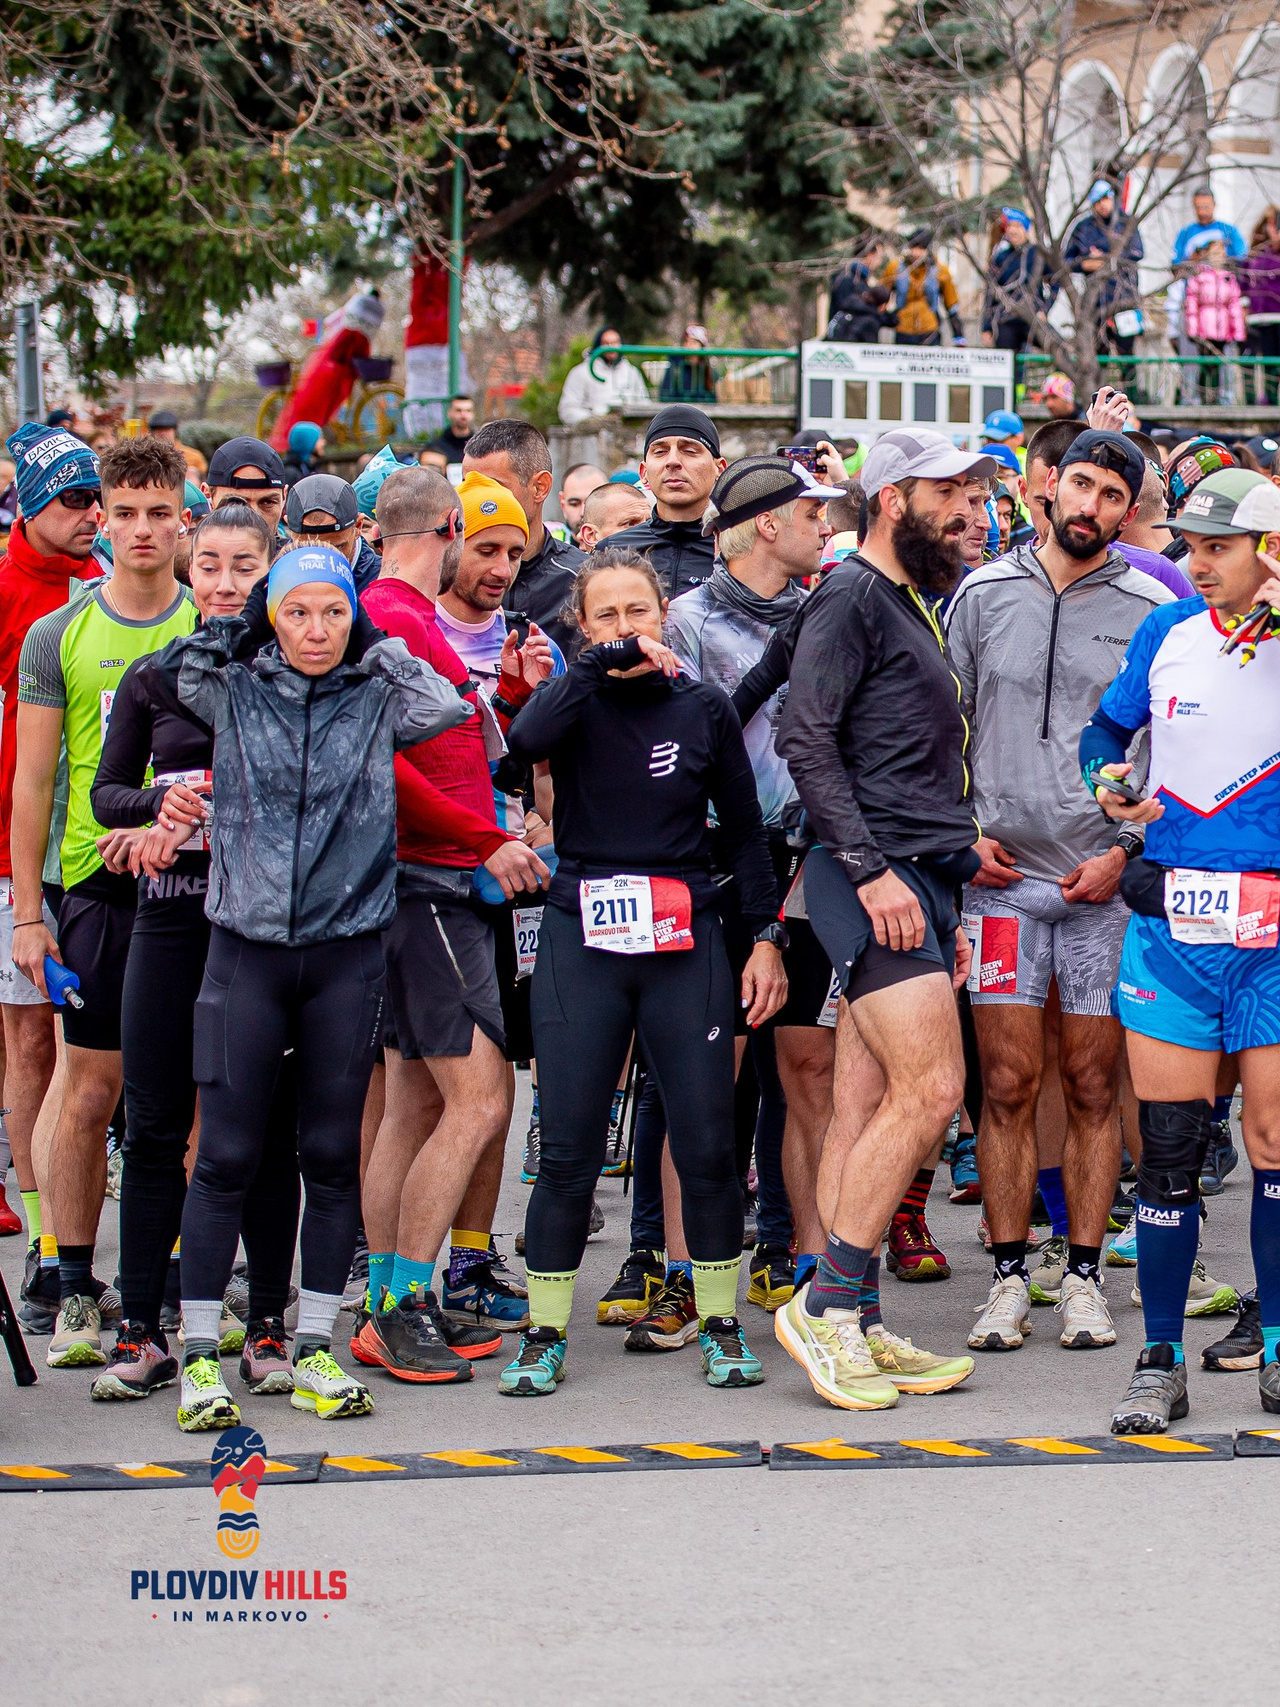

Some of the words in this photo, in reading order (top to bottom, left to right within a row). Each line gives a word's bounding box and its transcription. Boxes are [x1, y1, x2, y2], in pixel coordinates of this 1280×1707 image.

[300, 561, 327, 571] TRAIL
[1103, 635, 1132, 646] TERRE
[1214, 781, 1239, 802] EVERY
[1238, 767, 1258, 784] STEP
[788, 855, 798, 876] MILLET
[147, 873, 208, 899] NIKE
[614, 879, 628, 888] 22K
[1172, 890, 1229, 916] 2124
[592, 897, 638, 926] 2111
[588, 928, 615, 937] MARKOVO
[616, 926, 631, 935] TRAIL
[654, 927, 674, 939] STEP
[518, 929, 541, 955] 22
[980, 968, 999, 980] STEP
